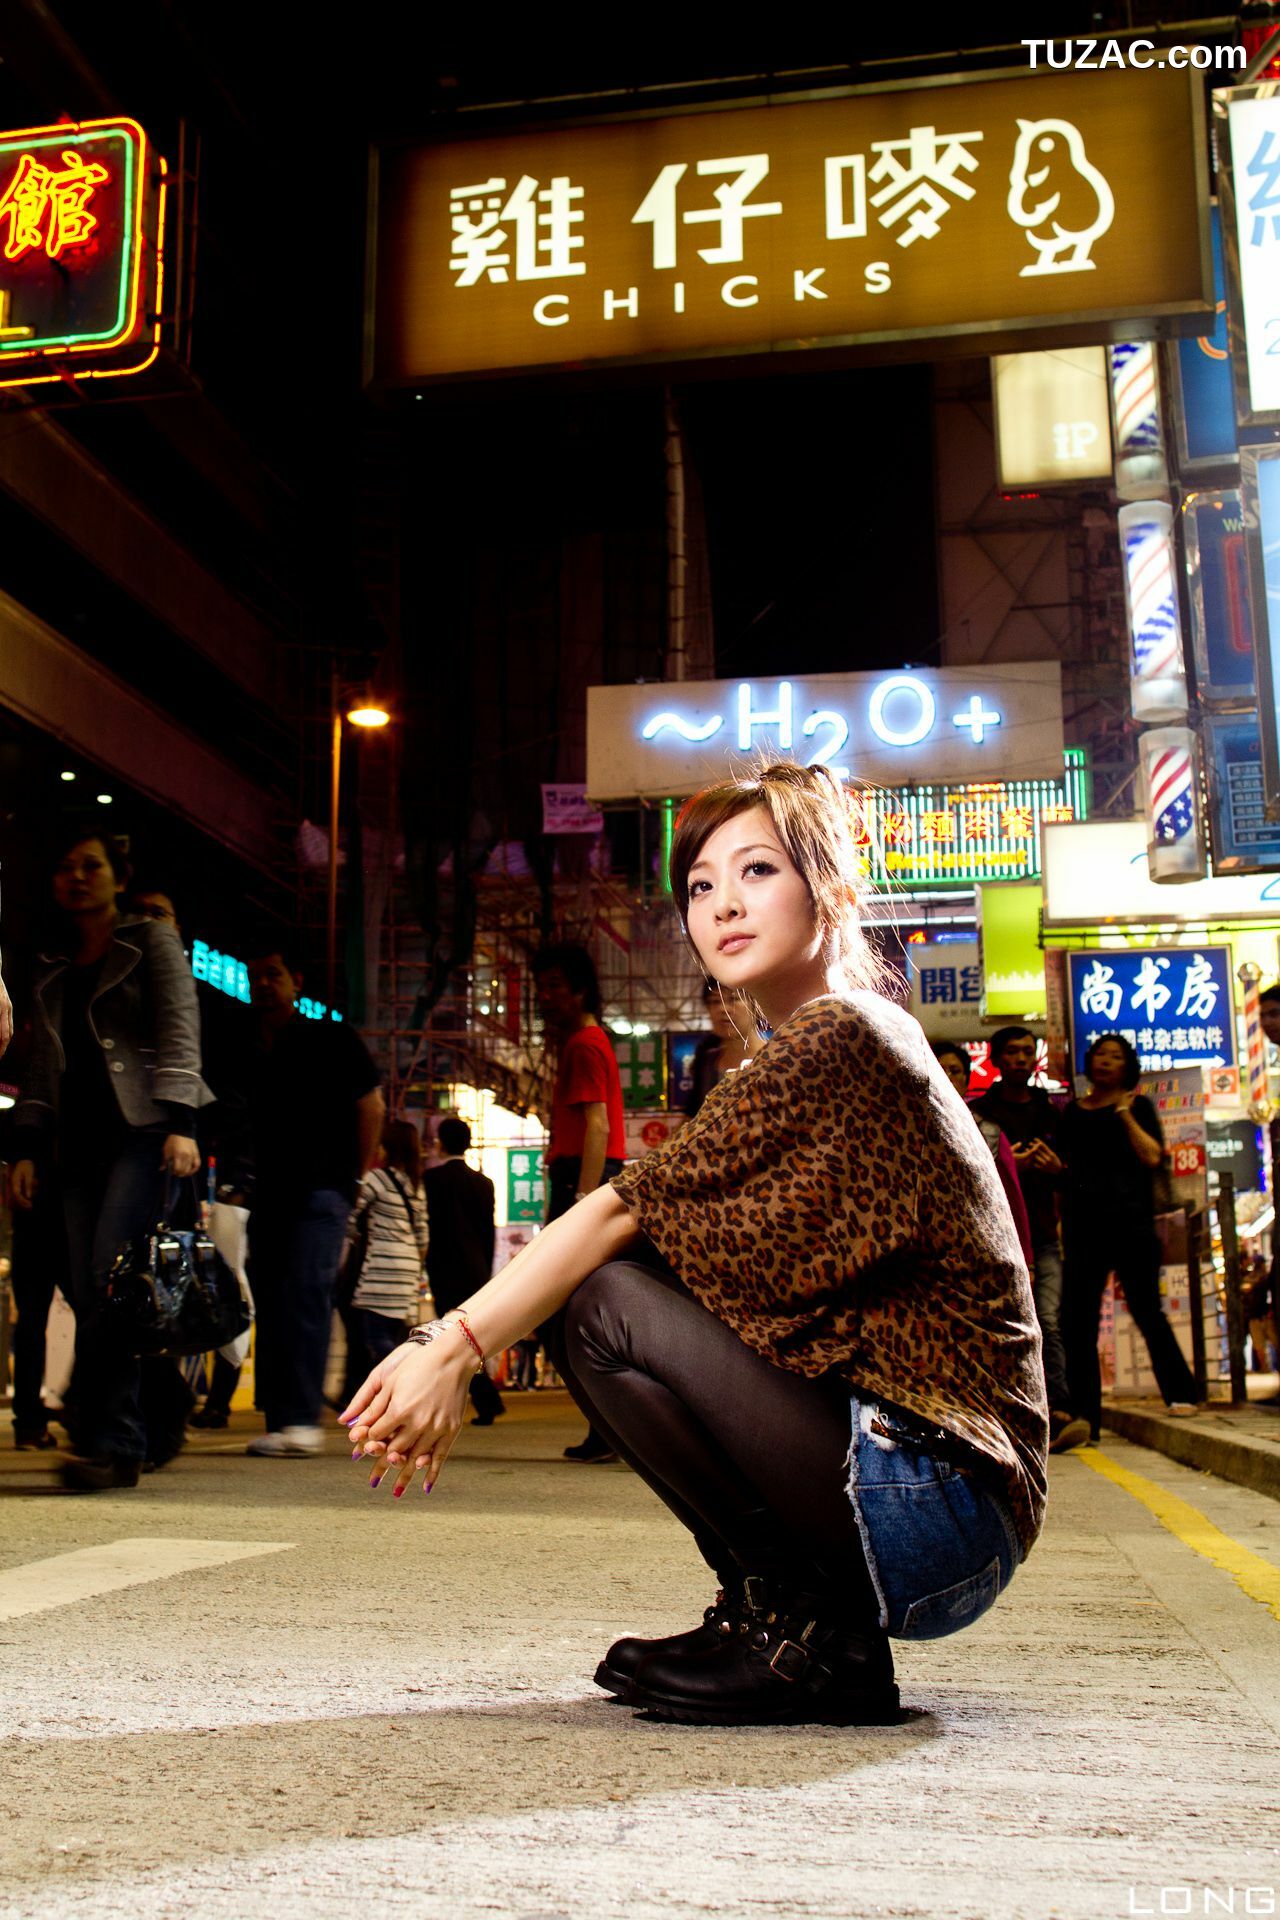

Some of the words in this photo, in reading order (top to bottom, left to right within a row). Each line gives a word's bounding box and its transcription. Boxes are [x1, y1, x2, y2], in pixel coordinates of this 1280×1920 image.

[450, 126, 984, 287] 雞仔嘜
[533, 261, 893, 327] CHICKS
[1080, 953, 1220, 1023] 尚书房
